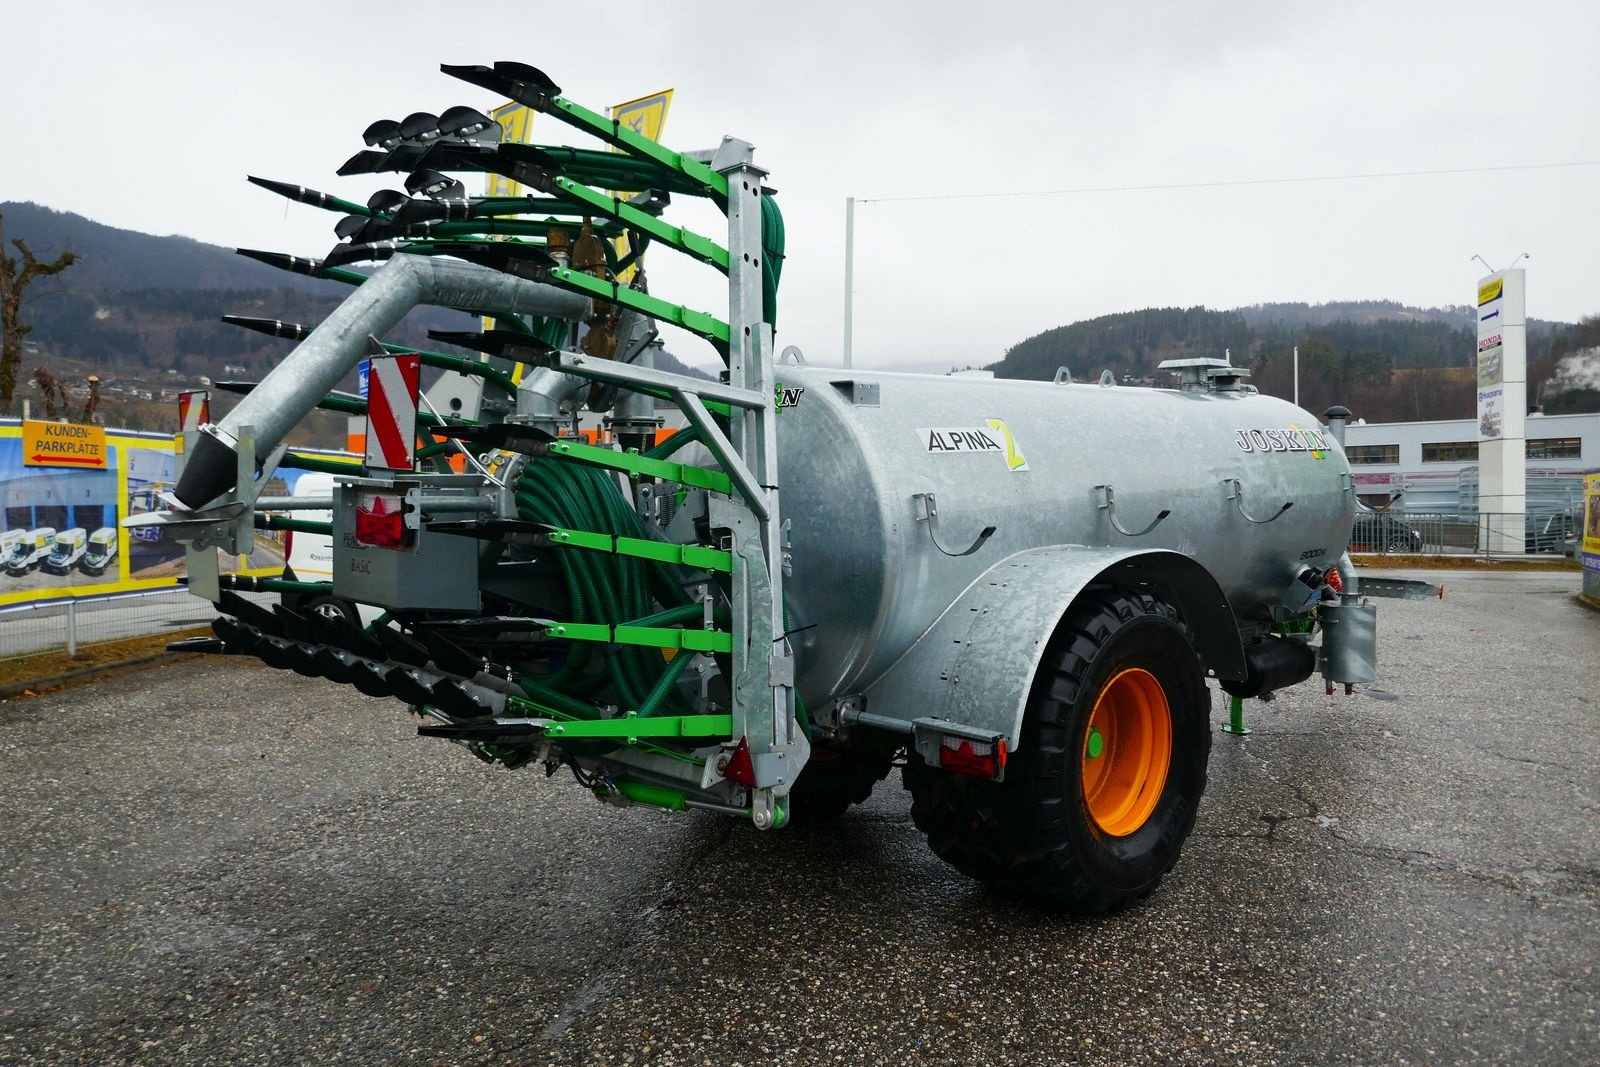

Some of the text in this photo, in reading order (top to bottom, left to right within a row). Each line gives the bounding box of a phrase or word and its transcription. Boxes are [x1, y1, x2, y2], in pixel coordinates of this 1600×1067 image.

[1478, 334, 1502, 348] HONDA
[45, 424, 92, 439] KUNDEN-
[35, 440, 100, 455] PARKPLÄTZE
[928, 429, 1001, 451] ALPINA
[1235, 429, 1332, 453] JOSKIN
[351, 558, 371, 575] BASIC
